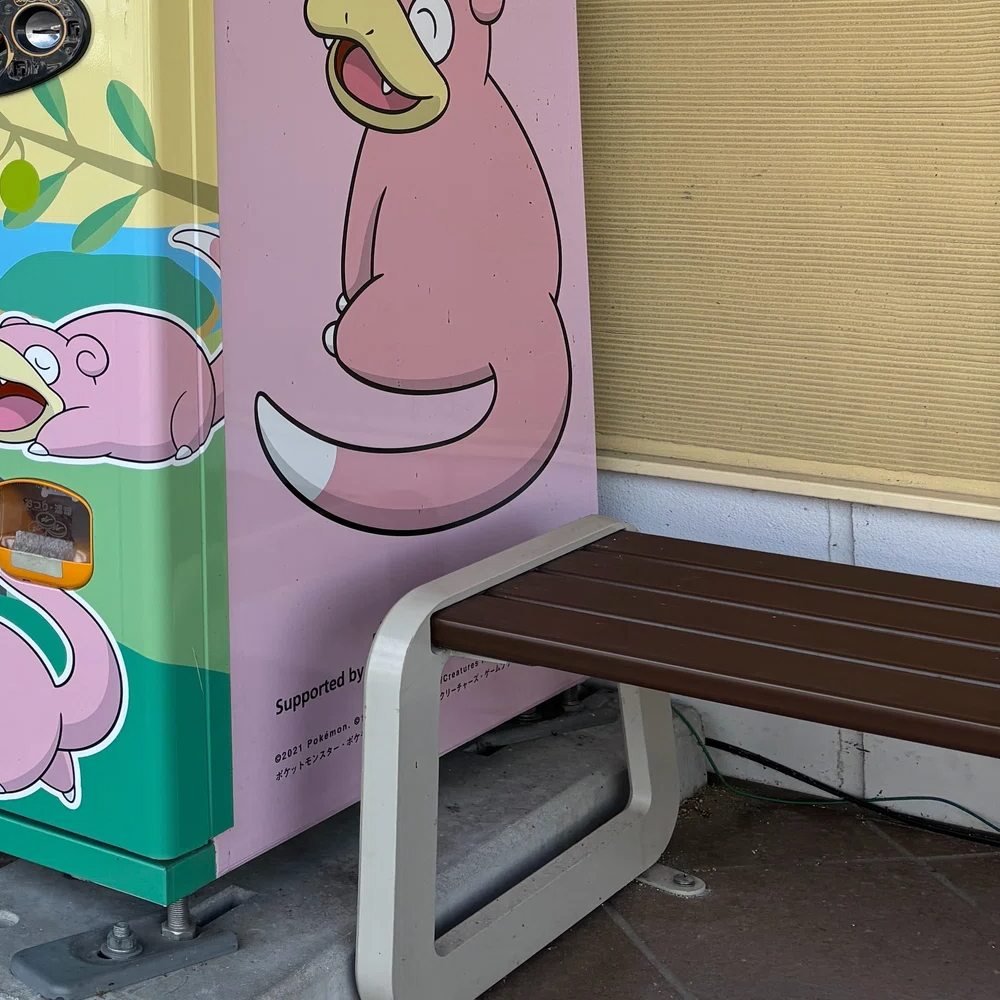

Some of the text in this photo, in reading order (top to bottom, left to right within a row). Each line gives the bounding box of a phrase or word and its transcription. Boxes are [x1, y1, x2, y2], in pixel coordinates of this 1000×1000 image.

[275, 665, 364, 716] Supported by
[274, 724, 350, 764] ©2021 Pokémon.
